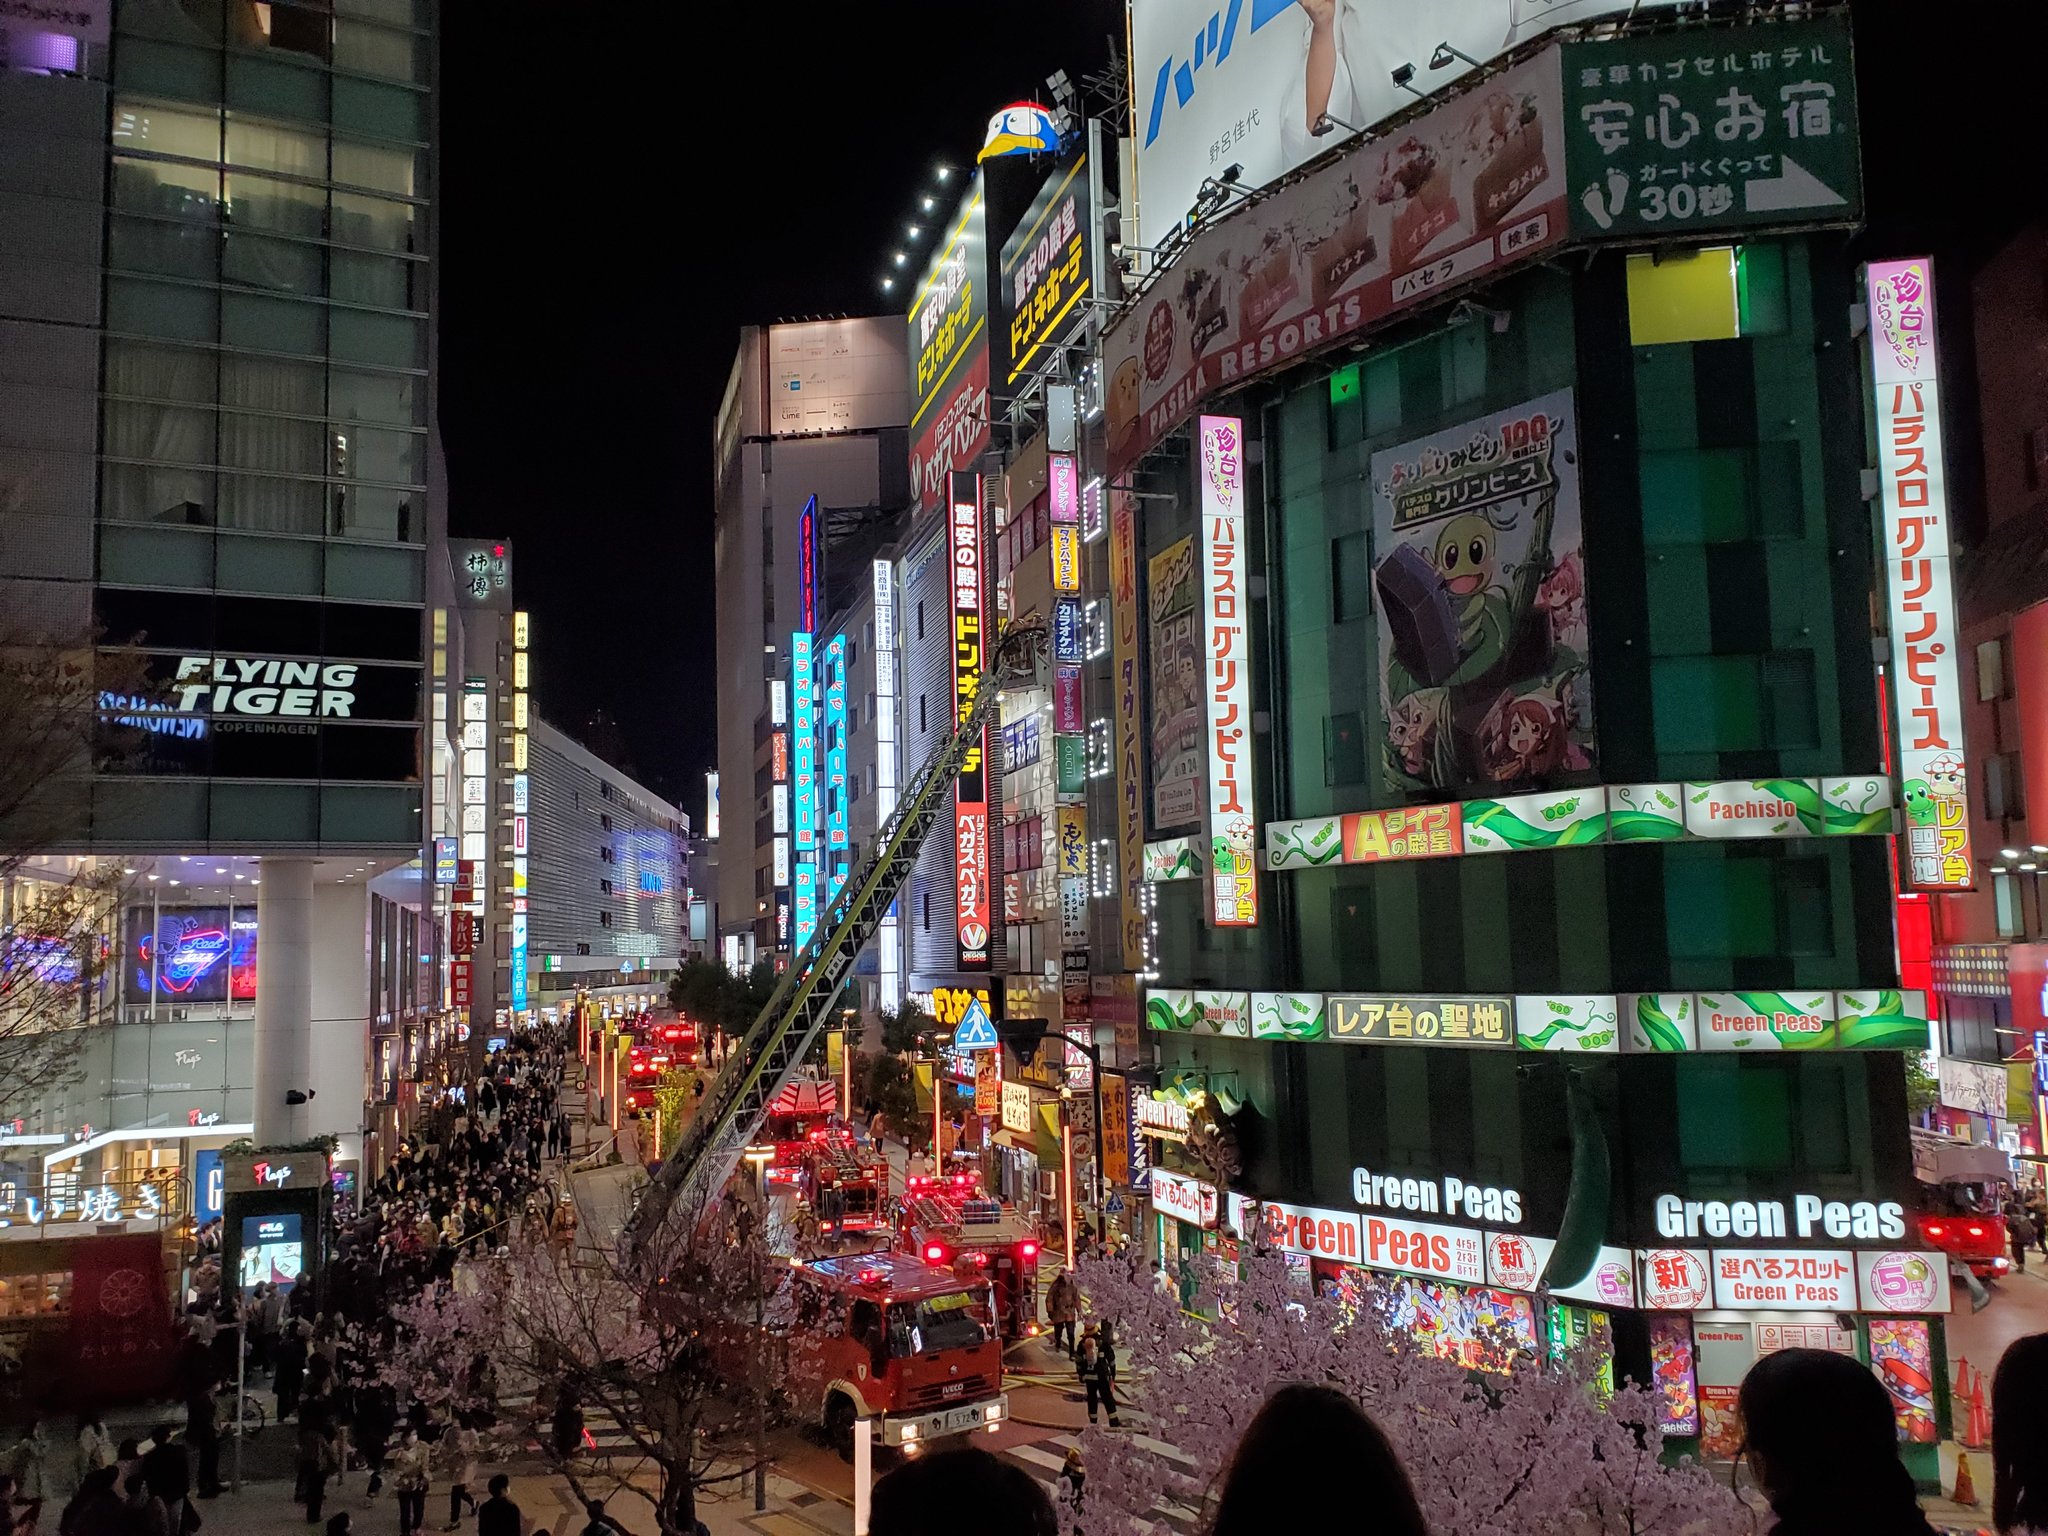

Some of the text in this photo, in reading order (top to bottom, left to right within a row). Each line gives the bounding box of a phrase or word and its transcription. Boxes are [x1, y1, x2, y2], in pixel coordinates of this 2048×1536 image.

[1581, 45, 1832, 87] 豪華カプセルホテル
[1581, 80, 1836, 155] 安心お宿
[1209, 108, 1260, 165] 野呂佳代
[1640, 154, 1772, 182] ガードくぐって
[1640, 183, 1734, 221] 30秒
[1507, 222, 1541, 250] 検索
[1330, 249, 1366, 281] バナナ
[1150, 295, 1362, 437] PASELA RESORTS
[1500, 411, 1549, 452] 100
[953, 503, 978, 609] 驚安の殿堂
[1891, 382, 1950, 750] パチスログリンピース
[1058, 603, 1073, 655] カラオケ747
[175, 656, 358, 688] FLYING
[1211, 516, 1243, 814] パチスログリンピース
[171, 684, 356, 718] TIGER
[213, 721, 319, 736] COPENHAGEN
[796, 641, 812, 844] カラオケ&パーティー館
[777, 794, 785, 829] ホットヨガ
[1709, 801, 1798, 820] Pachislo
[777, 838, 785, 869] スタジオ
[958, 814, 978, 919] ベガスベガス
[1153, 853, 1178, 870] Pachislo
[1908, 826, 1941, 885] 聖地
[1214, 875, 1235, 921] 聖地
[456, 913, 468, 953] マルハン
[1203, 1006, 1239, 1022] Green Peas
[1336, 1002, 1504, 1040] レア台の聖地
[1711, 1012, 1823, 1033] Green Peas
[175, 1048, 202, 1069] Flags
[382, 1040, 391, 1101] GAP
[410, 1029, 418, 1079] GAP
[188, 1108, 220, 1130] Flags
[1137, 1094, 1167, 1128] Green
[253, 1162, 292, 1190] Flags
[1154, 1179, 1200, 1213] 選べるスロット
[1352, 1166, 1523, 1225] Green Peas
[1656, 1193, 1907, 1239] Green Peas
[1266, 1204, 1452, 1273] Green Peas
[1455, 1237, 1477, 1250] 4F5F
[1498, 1238, 1526, 1272] 新
[1456, 1251, 1478, 1263] 2F3F
[1654, 1255, 1690, 1291] 新
[1720, 1258, 1849, 1281] 選べるスロット
[1498, 1269, 1533, 1285] スロット
[1733, 1281, 1839, 1302] Green Peas
[1654, 1291, 1702, 1305] スロット
[1699, 1332, 1744, 1341] Green Peas
[942, 1383, 964, 1394] IVECO
[1705, 1387, 1726, 1396] Green
